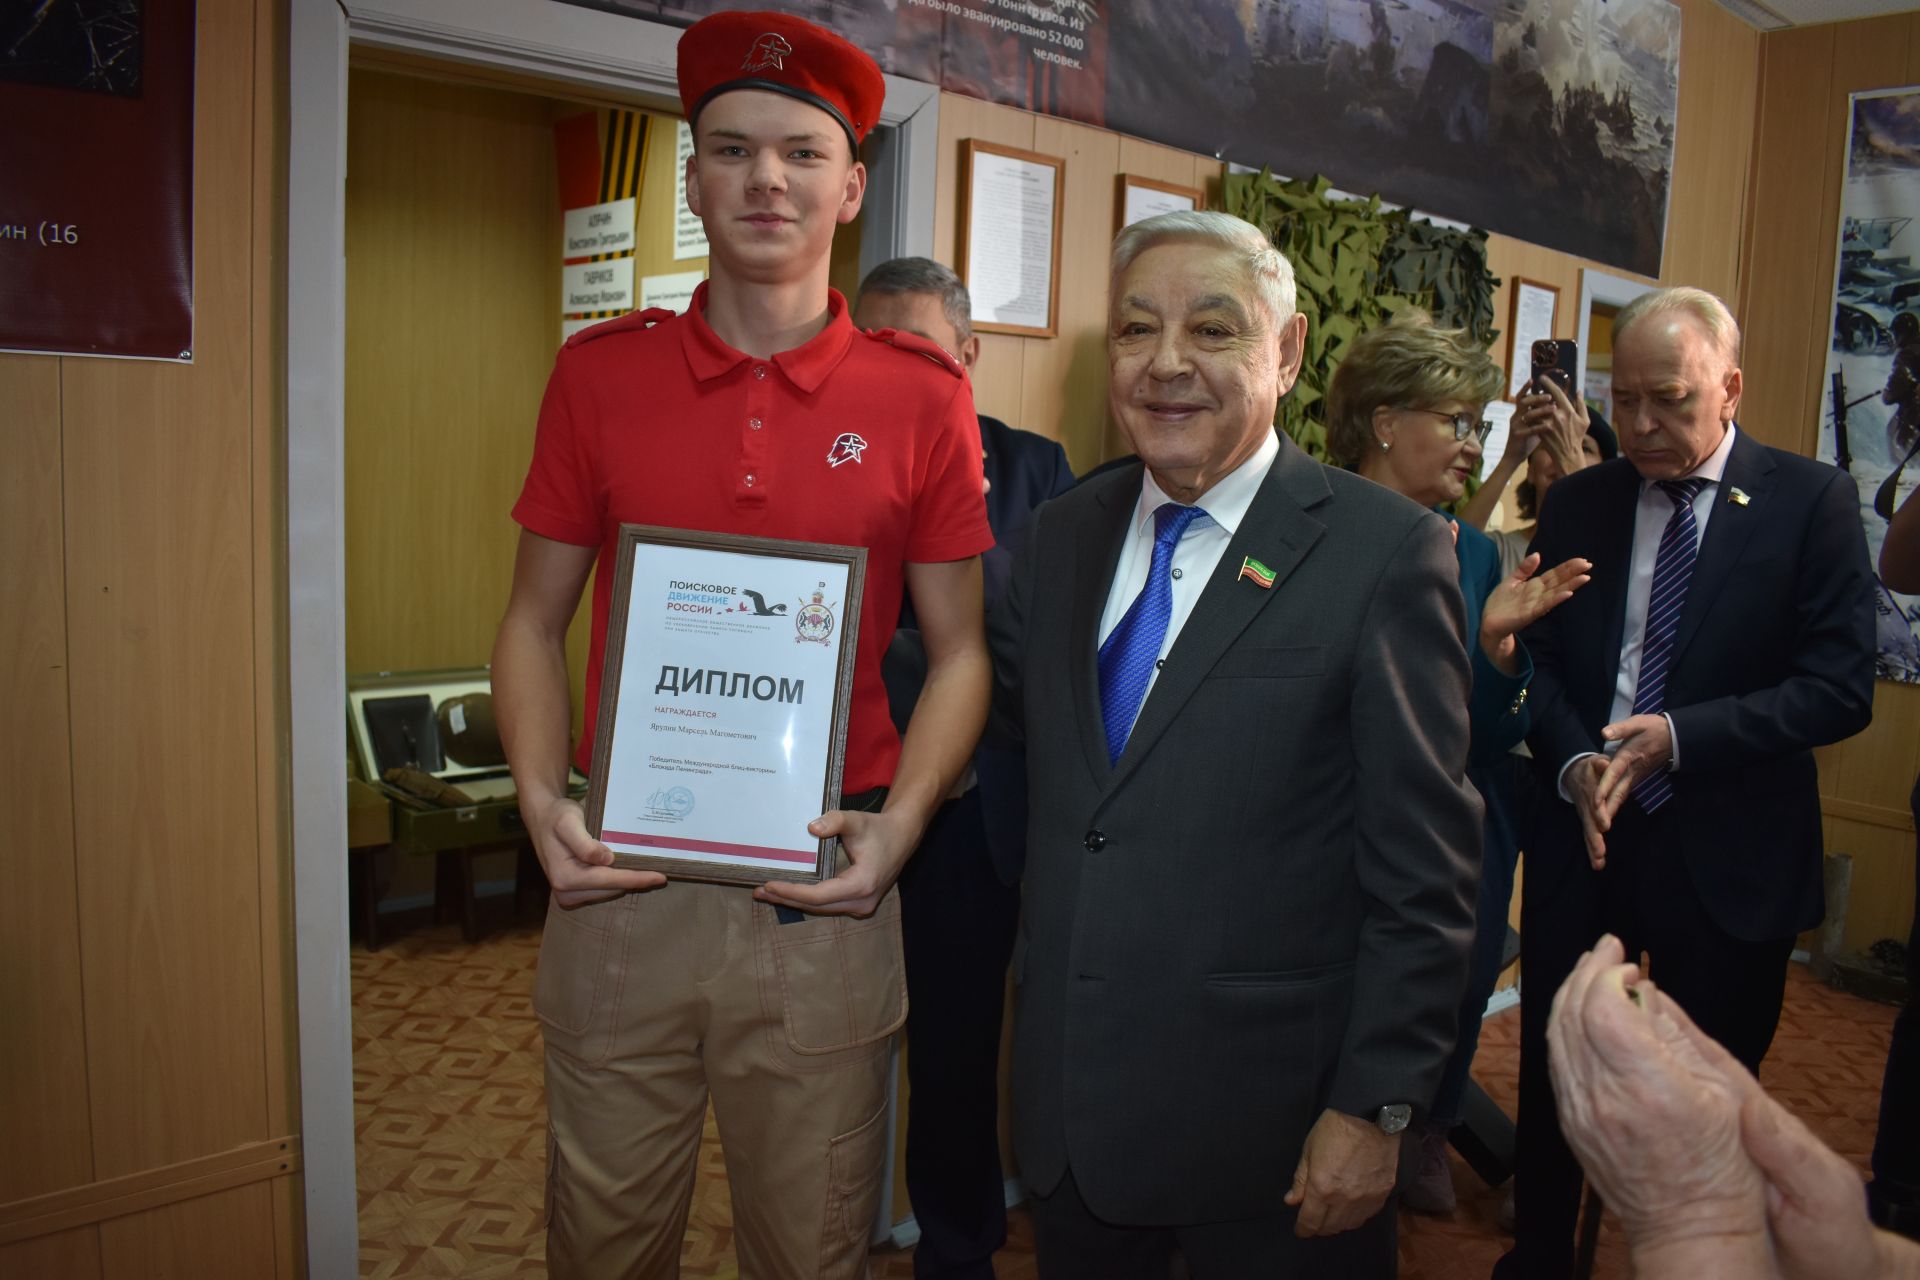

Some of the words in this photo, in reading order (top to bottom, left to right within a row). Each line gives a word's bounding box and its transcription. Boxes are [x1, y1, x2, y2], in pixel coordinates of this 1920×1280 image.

[928, 0, 961, 15] было
[962, 7, 1047, 40] эвакуировано
[1048, 31, 1062, 44] 52
[1063, 37, 1084, 51] 000
[1070, 16, 1086, 32] Из
[1033, 47, 1083, 70] человек.
[38, 220, 79, 247] (16
[669, 580, 738, 596] ПОИСКОВОЕ
[667, 591, 729, 606] ДВИЖЕНИЕ
[666, 602, 713, 615] РОССИИ
[654, 664, 805, 705] ДИПЛОМ
[654, 706, 718, 719] НАГРАЖДАЕТСЯ
[709, 729, 757, 741] Магометович
[649, 755, 683, 765] Победитель
[684, 759, 730, 769] Международной
